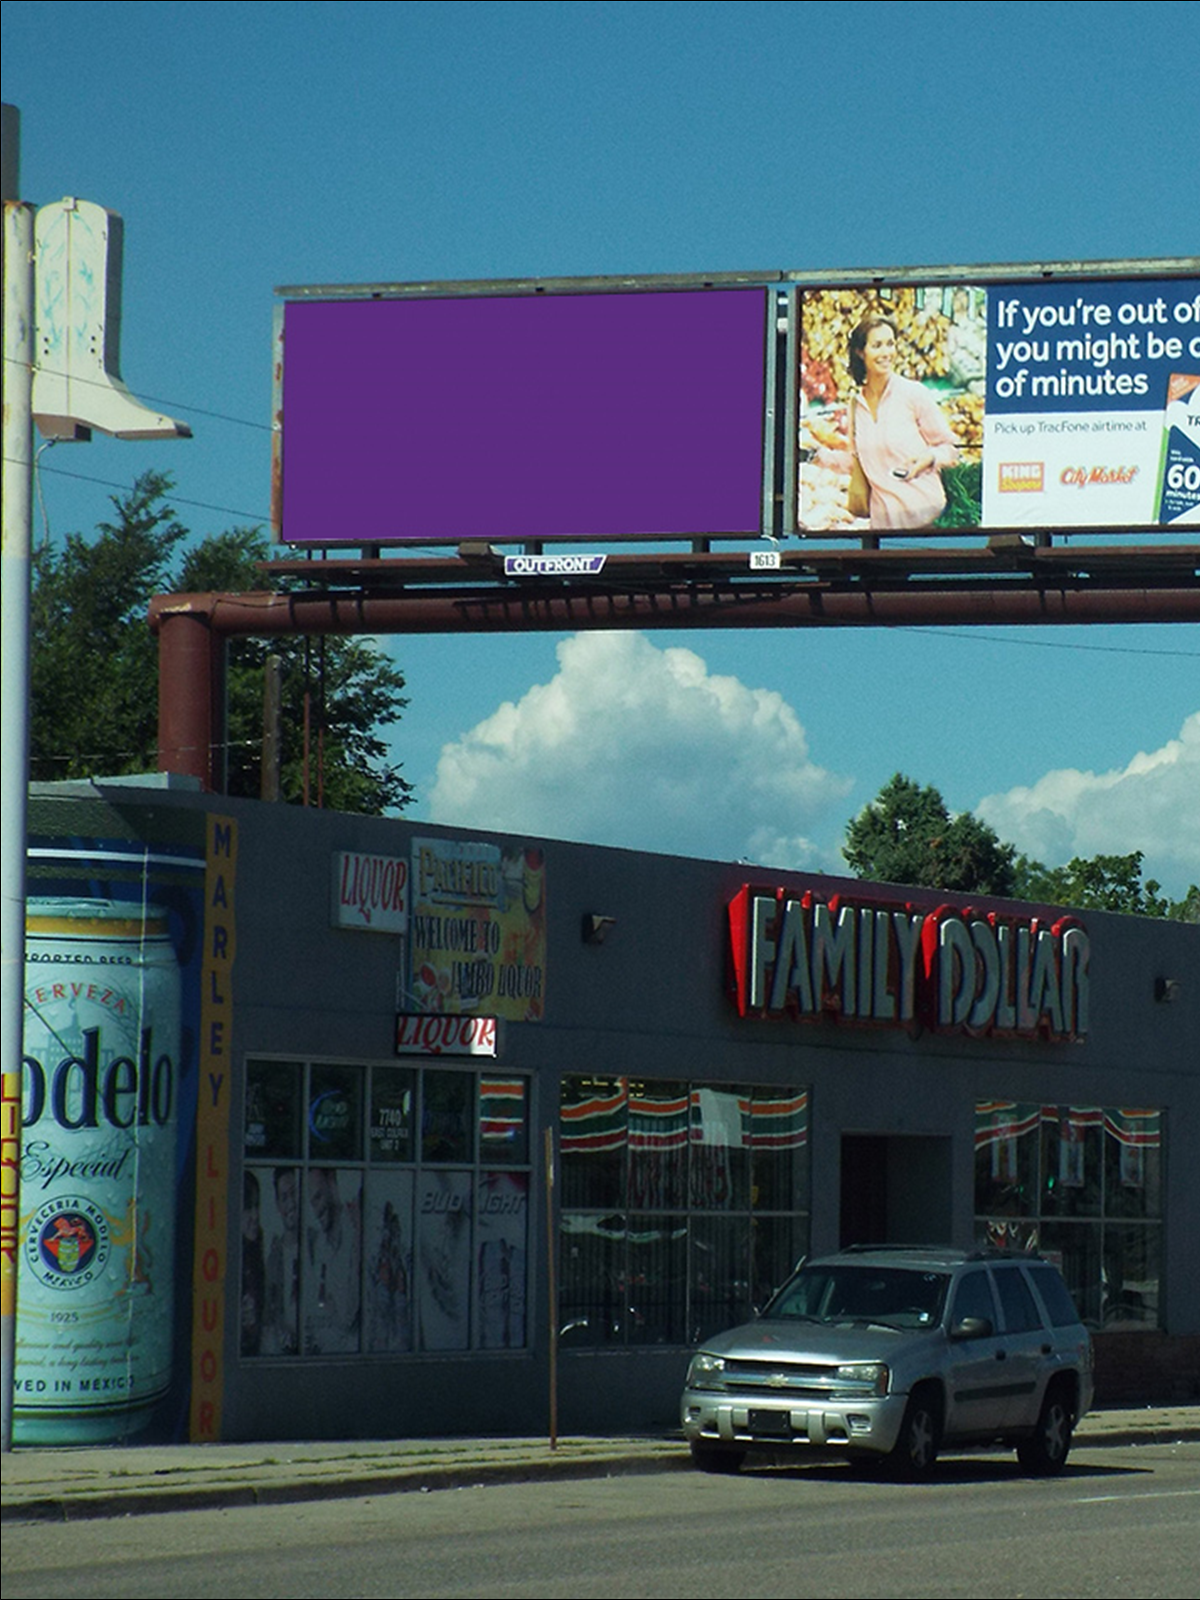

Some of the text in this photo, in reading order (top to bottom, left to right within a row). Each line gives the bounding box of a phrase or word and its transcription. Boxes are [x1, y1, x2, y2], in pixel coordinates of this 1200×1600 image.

[998, 300, 1019, 328] If
[1022, 298, 1112, 335] you're
[1118, 298, 1168, 325] out
[996, 342, 1048, 370] you
[1056, 333, 1141, 368] might
[1147, 331, 1182, 359] be
[996, 369, 1029, 397] of
[1032, 369, 1149, 396] minutes
[994, 420, 1147, 435] Pick up TracFone airtime at
[1060, 466, 1088, 488] City
[513, 557, 595, 573] OUTFRONT
[754, 553, 776, 567] 1613
[341, 855, 406, 924] LIQUOR
[415, 916, 500, 954] WELCOME TO
[497, 963, 542, 999] LIQUOR
[750, 895, 1091, 1037] FAMILY DOLLAR
[24, 982, 127, 1014] ERVEZA
[398, 1016, 496, 1055] LIQUOR
[20, 1027, 172, 1129] odelo
[200, 823, 231, 1434] MARLEY LIQUOR
[29, 1199, 80, 1263] CERVECERIA
[50, 1311, 79, 1323] 1925
[55, 1380, 71, 1391] IN
